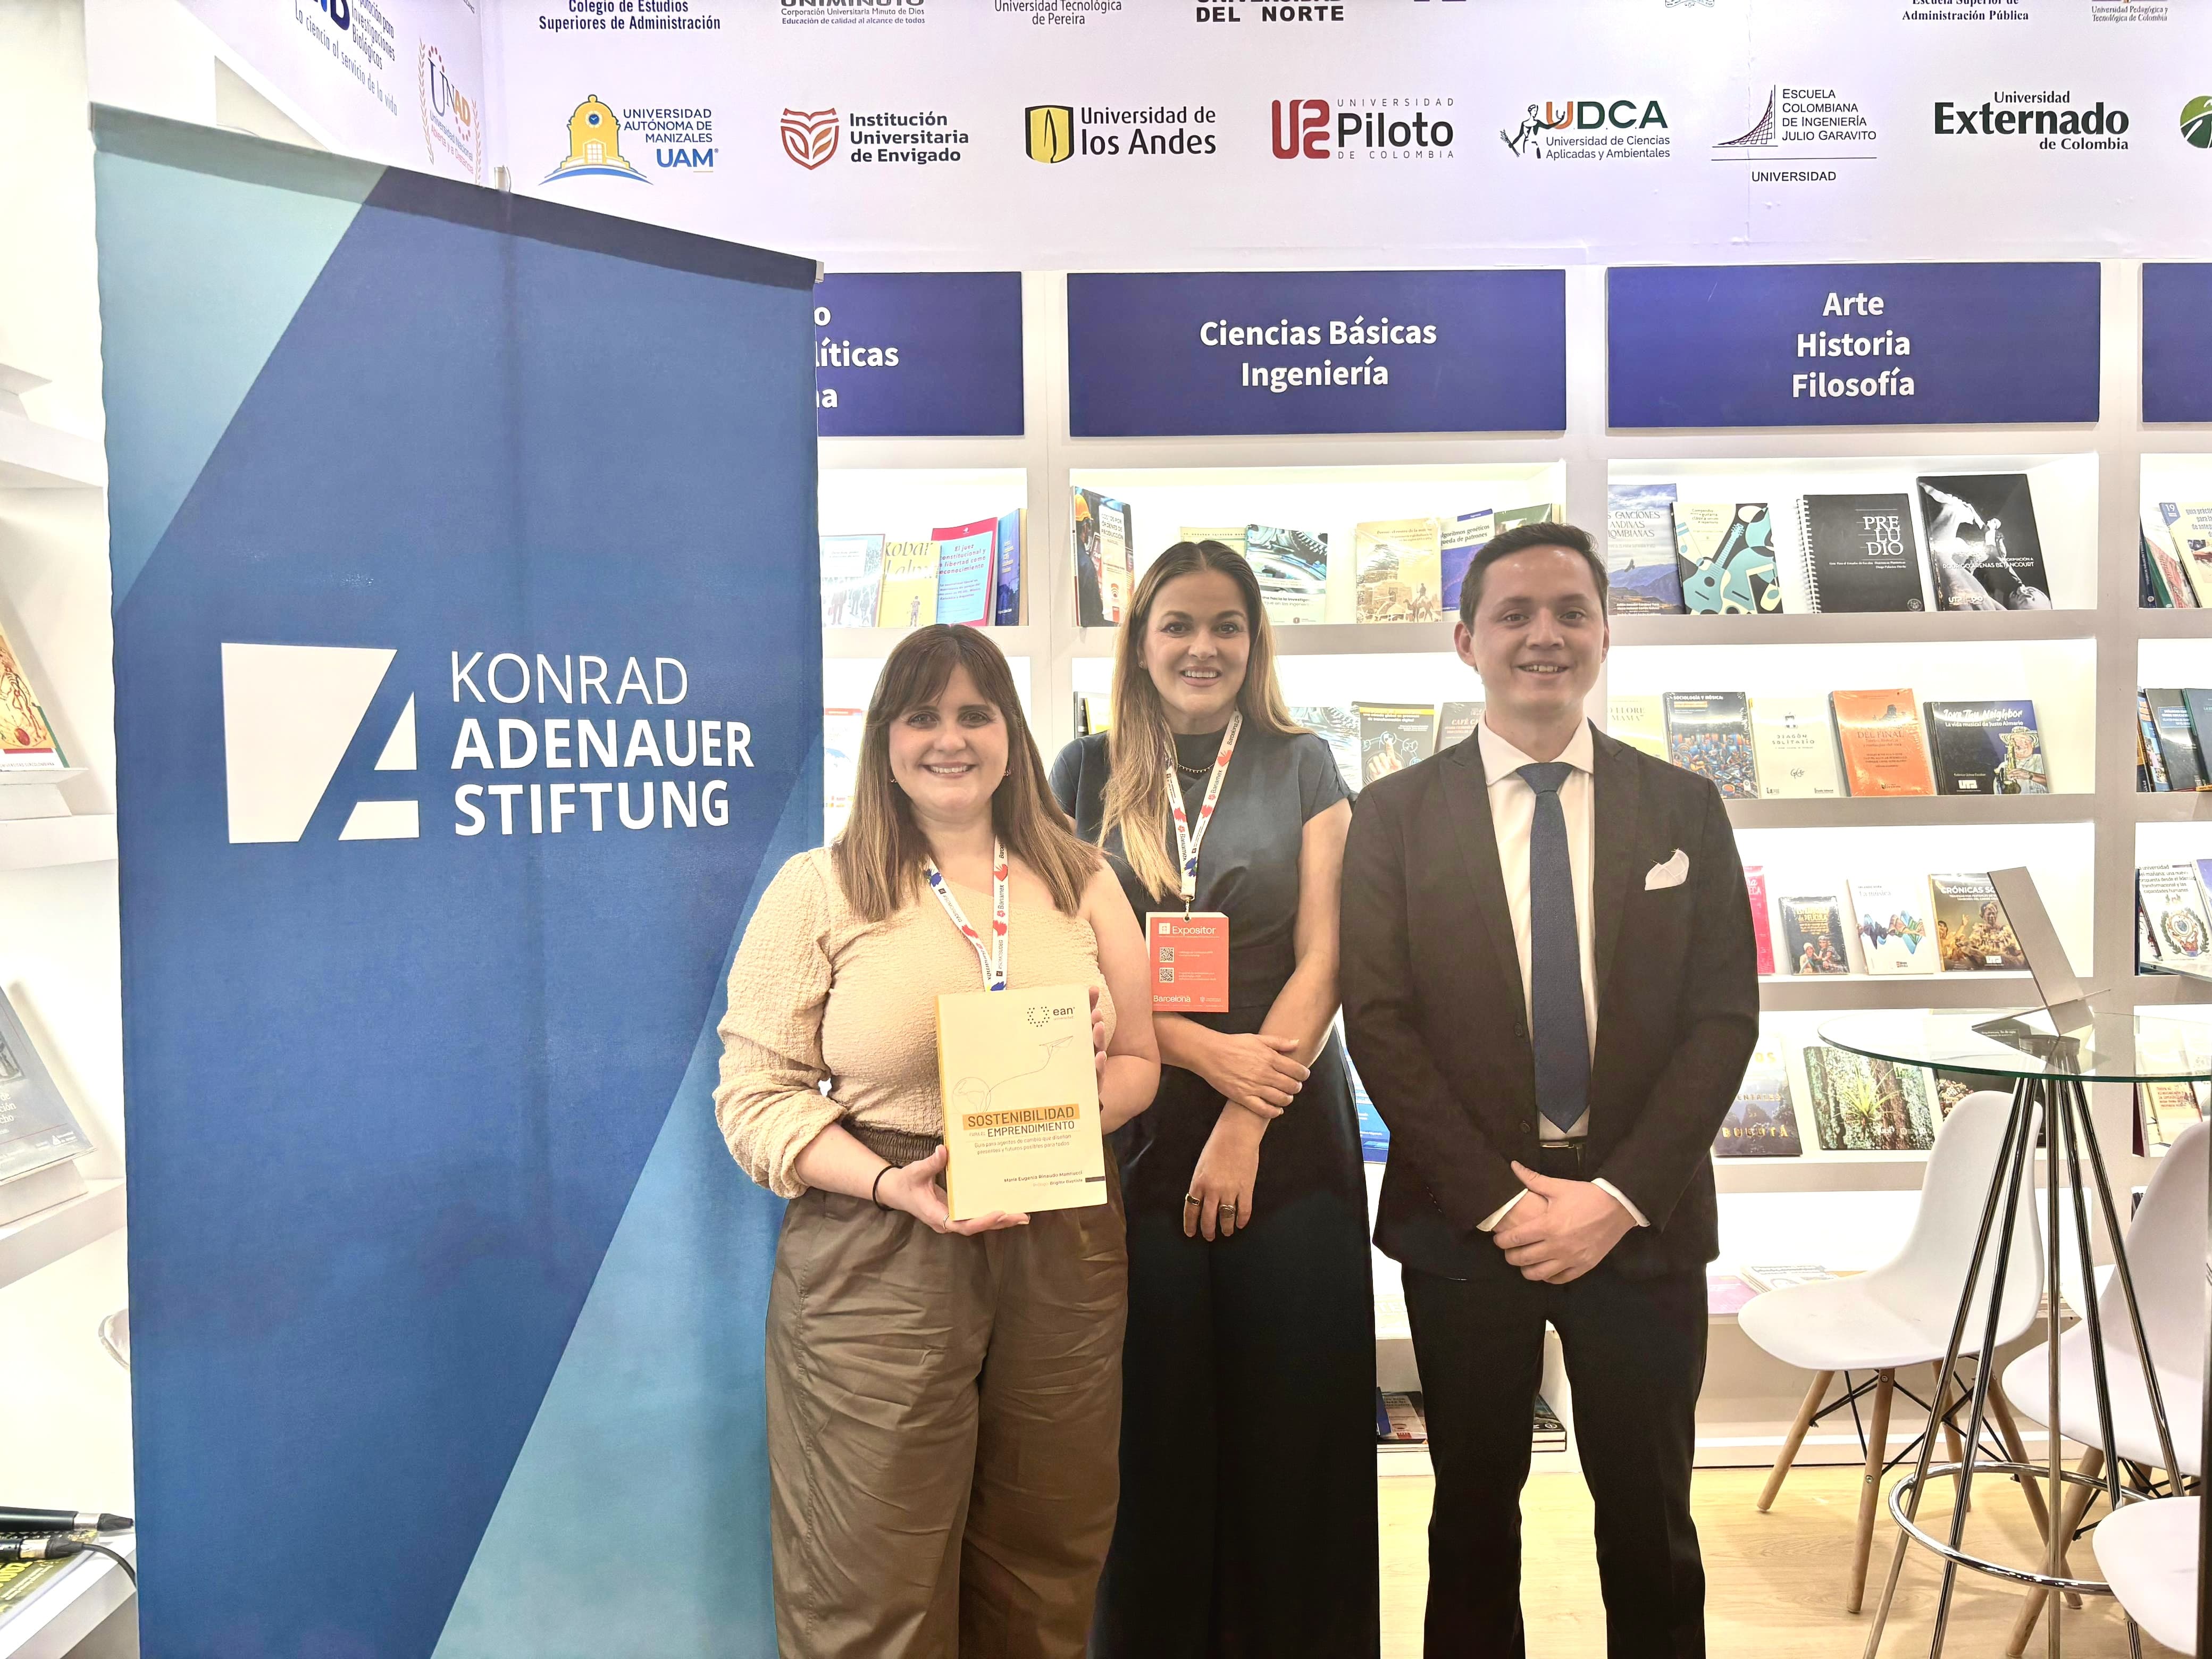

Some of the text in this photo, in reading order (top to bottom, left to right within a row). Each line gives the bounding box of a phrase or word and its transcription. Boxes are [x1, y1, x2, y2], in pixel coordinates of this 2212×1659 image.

[569, 0, 689, 15] Colegio de Estudios
[781, 8, 825, 16] Corporación
[994, 0, 1122, 14] Universidad Tecnológica
[1196, 6, 1344, 22] DEL NORTE
[1032, 13, 1085, 25] de Pereira
[1902, 10, 2029, 20] Administración Pública
[383, 16, 394, 39] para
[539, 15, 720, 32] Superiores de Administración
[352, 23, 382, 70] Biológicas
[306, 15, 397, 116] ciencia al servicio de la vida
[428, 57, 471, 128] UNAD
[1782, 89, 1836, 99] ESCUELA
[1994, 91, 2070, 104] Universidad
[623, 108, 711, 119] UNIVERSIDAD
[1081, 106, 1216, 124] Universidad de
[1782, 103, 1858, 113] COLOMBIANA
[624, 119, 713, 131] AUTÓNOMA DE
[850, 111, 948, 128] Institución
[1782, 114, 1867, 127] DE INGENIERÍA
[1934, 102, 2129, 135] Externado
[430, 110, 473, 162] Universidad Nacional
[1338, 112, 1454, 148] Piloto
[1782, 130, 1877, 141] JULIO GARAVITO
[646, 133, 713, 143] MANIZALES
[850, 130, 969, 146] Universitaria
[1081, 128, 1217, 155] los Andes
[1546, 135, 1670, 147] Universidad de Ciencias
[2039, 138, 2129, 150] de Colombia
[431, 124, 474, 175] Abierta Distancia
[1338, 150, 1455, 159] DE COLOMBIA
[1546, 148, 1671, 161] Aplicadas y Ambientales
[851, 148, 961, 166] de Envigado
[1752, 171, 1837, 182] UNIVERSIDAD
[1822, 292, 1884, 317] Arte
[1200, 317, 1437, 347] Ciencias Básicas
[1796, 332, 1911, 358] Historia
[1242, 356, 1388, 392] Ingeniería
[1792, 367, 1915, 398] Filosofía
[1467, 524, 1490, 535] genéticos
[1610, 520, 1645, 529] ANDINAS
[1465, 532, 1488, 543] patrones
[1608, 529, 1655, 539] LOMBIANAS
[939, 564, 984, 575] econocimiento
[944, 558, 969, 568] libertad
[451, 650, 688, 706] KONRAD
[1982, 709, 2023, 721] Neighbor
[450, 718, 755, 770] ADENAUER
[1211, 769, 1223, 794] Banamex
[454, 780, 729, 836] STIFTUNG
[1940, 885, 1984, 894] CRÓNICAS
[1172, 926, 1217, 936] Expositor
[968, 1107, 1075, 1127] SOSTENIBILIDAD
[987, 1120, 1075, 1137] EMPRENDIMIENTO
[997, 1138, 1016, 1147] agentes
[977, 1146, 1001, 1155] presentes
